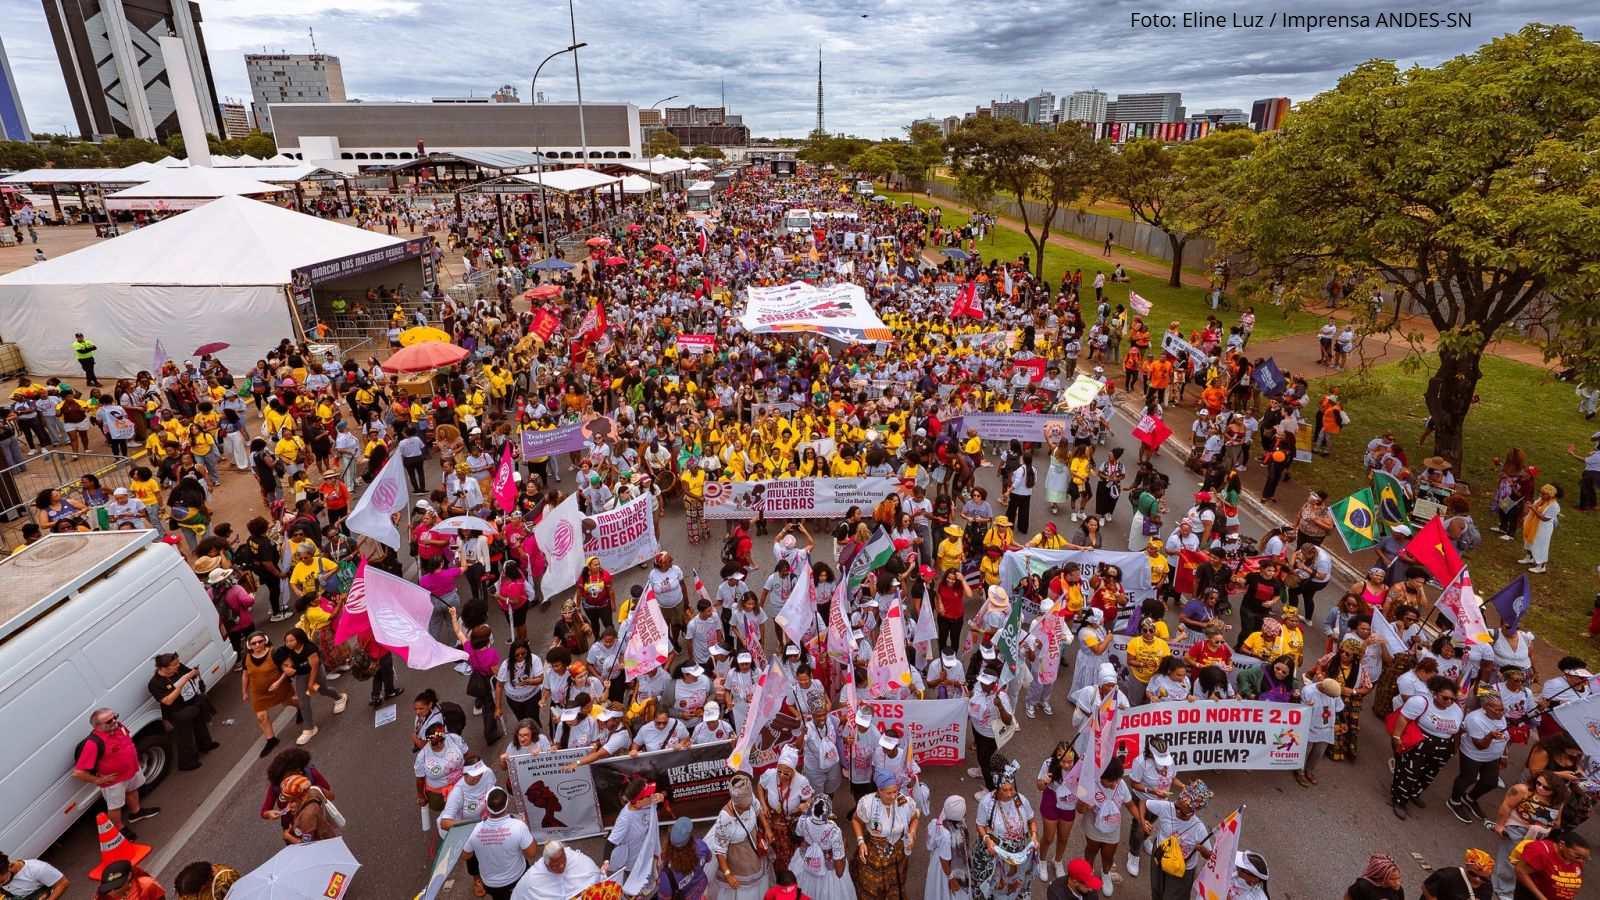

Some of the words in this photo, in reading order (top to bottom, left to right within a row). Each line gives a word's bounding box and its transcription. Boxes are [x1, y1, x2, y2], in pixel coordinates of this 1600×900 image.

[767, 481, 798, 489] MARCHA
[800, 480, 815, 488] DAS
[767, 488, 815, 498] MULHERES
[597, 507, 633, 525] MARCHA
[633, 498, 647, 513] DAS
[767, 498, 815, 511] NEGRAS
[599, 508, 648, 536] MULHERES
[600, 518, 648, 550] NEGRAS
[1116, 708, 1173, 730] AGOAS
[1178, 709, 1201, 724] DO
[1206, 707, 1264, 723] NORTE
[1269, 708, 1302, 725] 2.0
[928, 734, 960, 747] VIVER
[1228, 729, 1267, 745] VIVA
[924, 747, 955, 758] 2025
[1193, 749, 1250, 764] QUEM?
[667, 765, 686, 777] LUIZ
[687, 759, 727, 773] FERNAND
